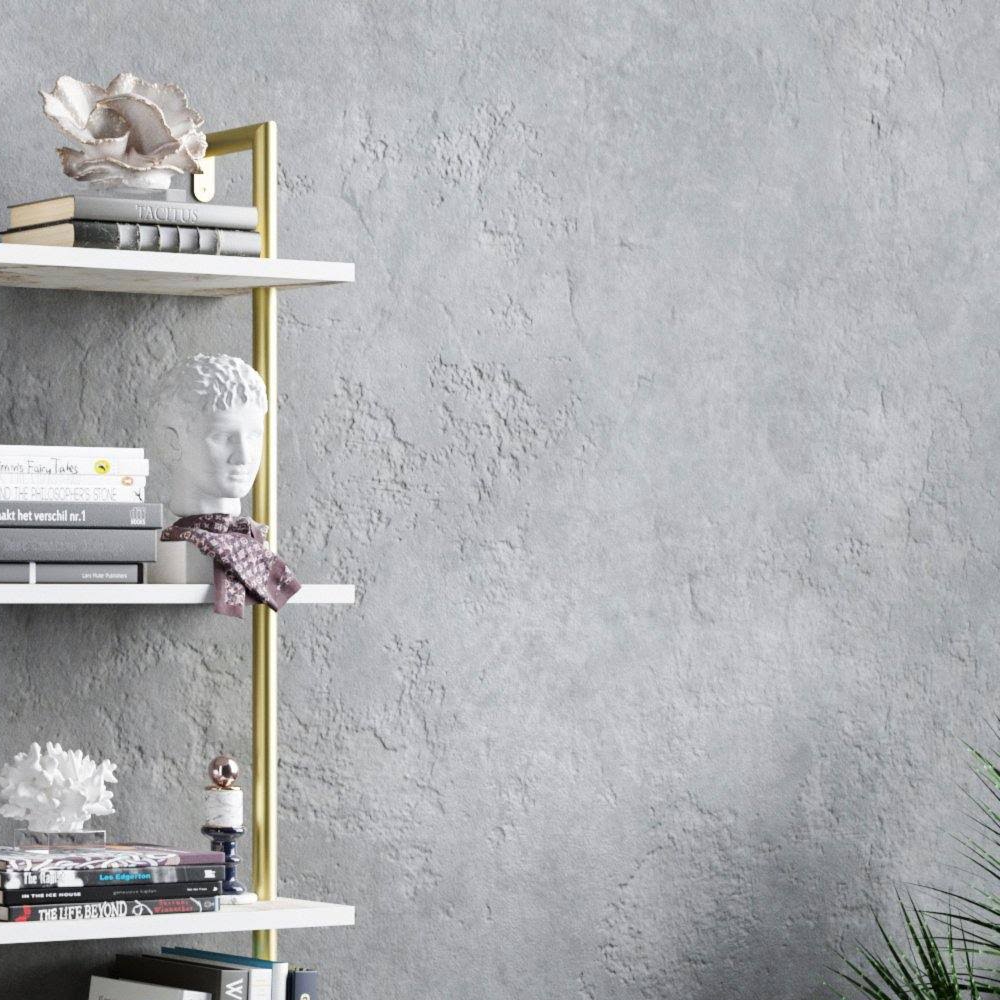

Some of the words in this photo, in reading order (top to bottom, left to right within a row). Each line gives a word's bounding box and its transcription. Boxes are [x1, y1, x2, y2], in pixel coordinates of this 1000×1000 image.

[135, 204, 199, 223] TACITUS
[28, 460, 51, 474] Fairy
[51, 458, 79, 474] Tales
[14, 487, 28, 500] THE
[94, 488, 117, 501] STONE
[18, 509, 32, 521] het
[34, 509, 68, 521] verschil
[70, 510, 86, 521] nr.1
[24, 872, 38, 885] The
[115, 871, 151, 881] Edgerton
[39, 908, 56, 921] THE
[59, 905, 83, 920] LIFE
[84, 901, 128, 918] BEYOND
